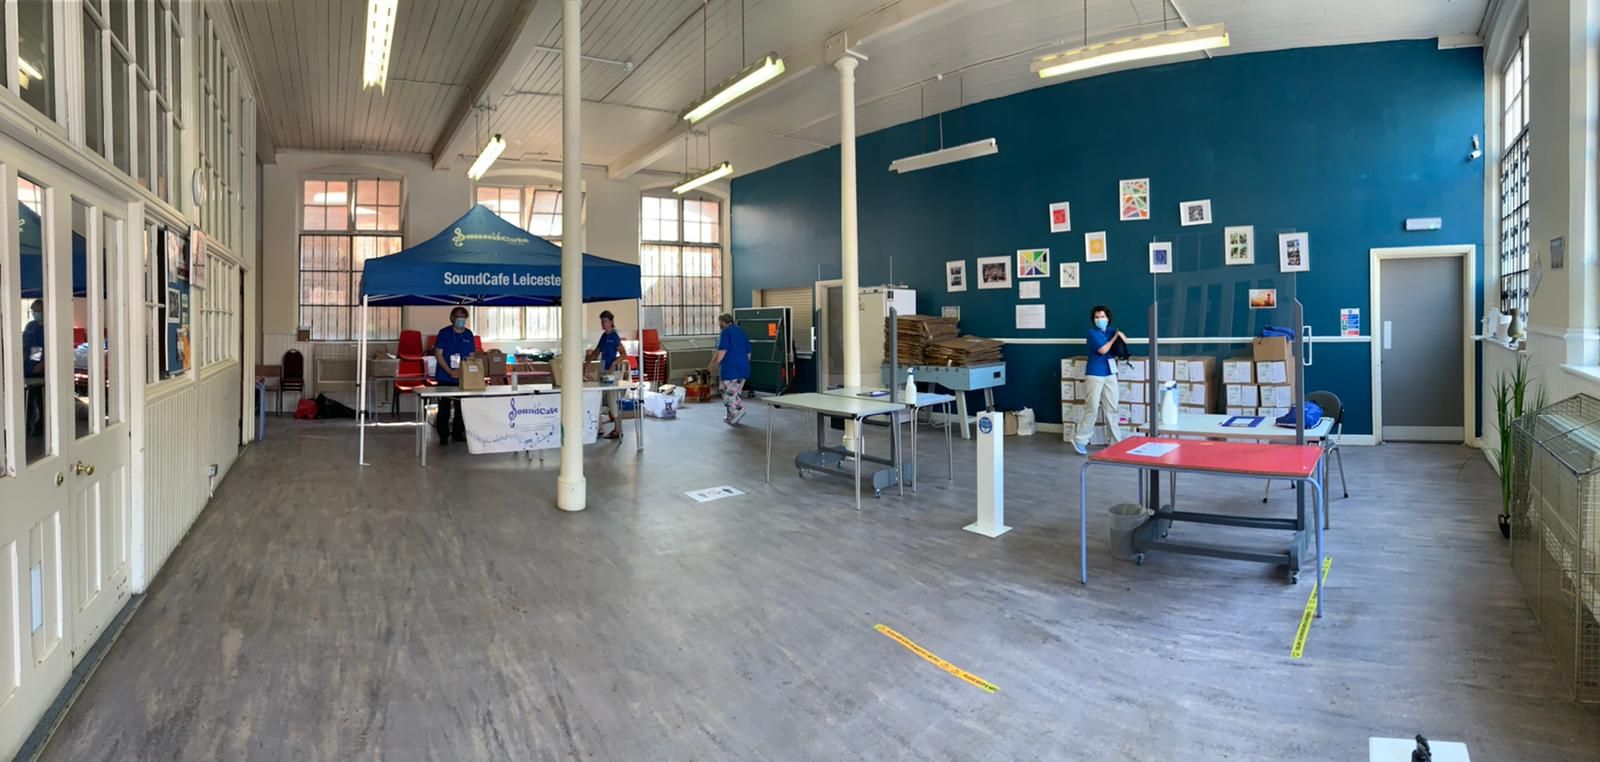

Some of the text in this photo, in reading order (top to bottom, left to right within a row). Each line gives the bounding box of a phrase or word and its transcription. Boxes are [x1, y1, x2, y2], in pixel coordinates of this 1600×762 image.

[443, 271, 562, 287] SoundCafe Leiceste
[508, 397, 559, 429] SoundCafe
